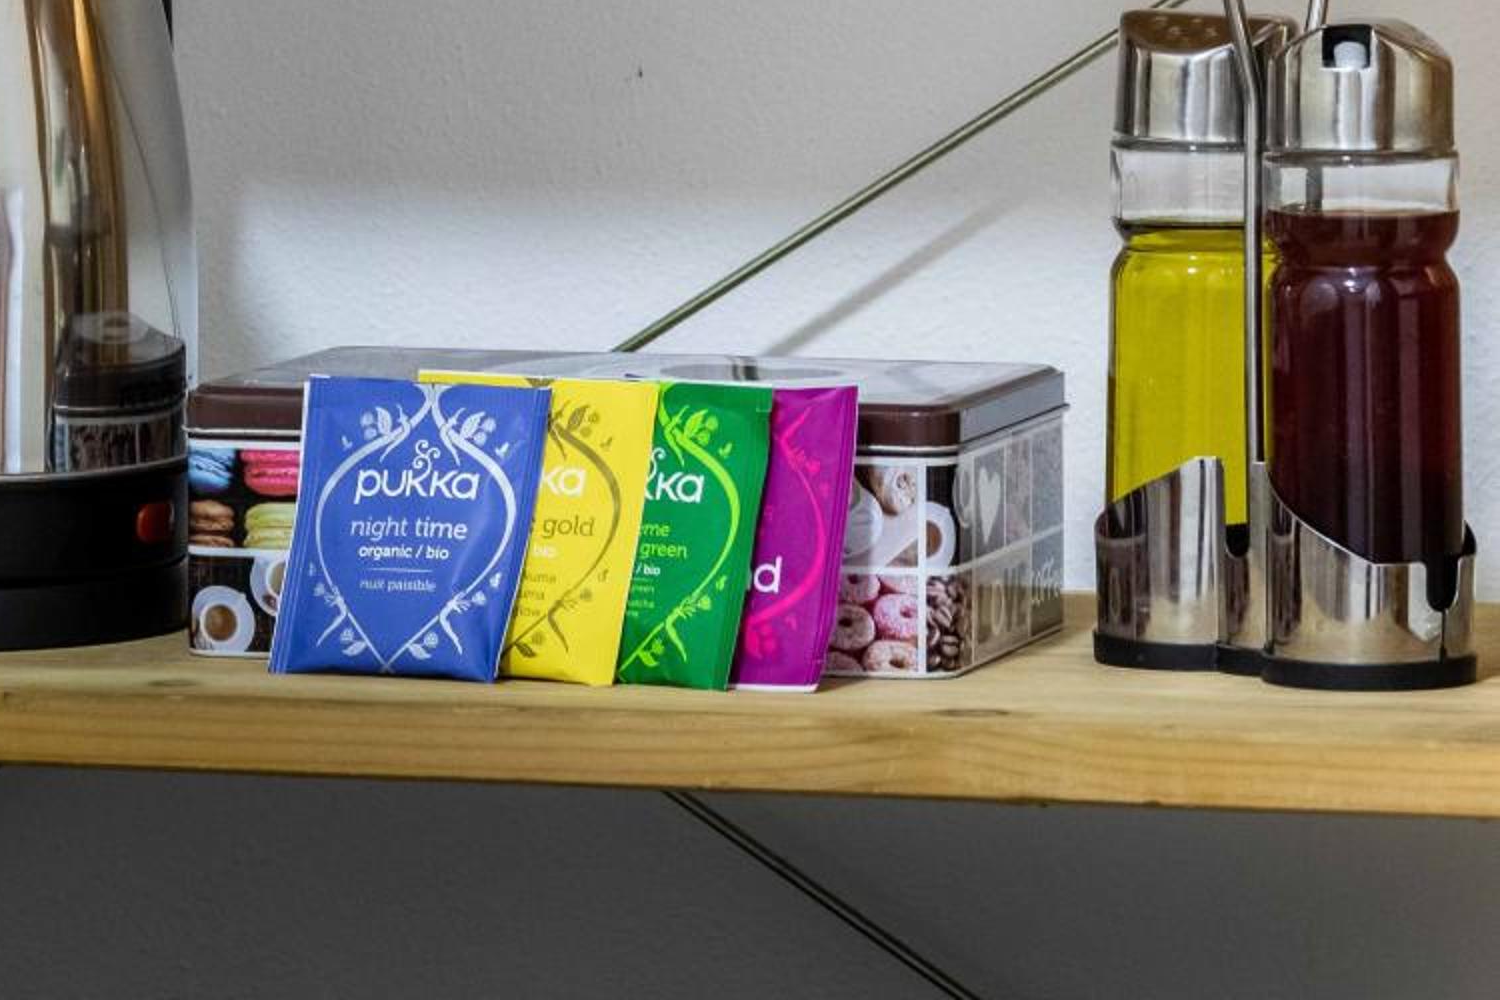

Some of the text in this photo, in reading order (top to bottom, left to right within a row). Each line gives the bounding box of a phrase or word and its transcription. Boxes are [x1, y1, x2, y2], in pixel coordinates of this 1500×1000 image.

[353, 440, 480, 504] pukka
[350, 516, 469, 541] night time
[542, 515, 596, 539] gold
[358, 546, 414, 561] organic
[425, 546, 450, 560] bio
[639, 541, 688, 560] green
